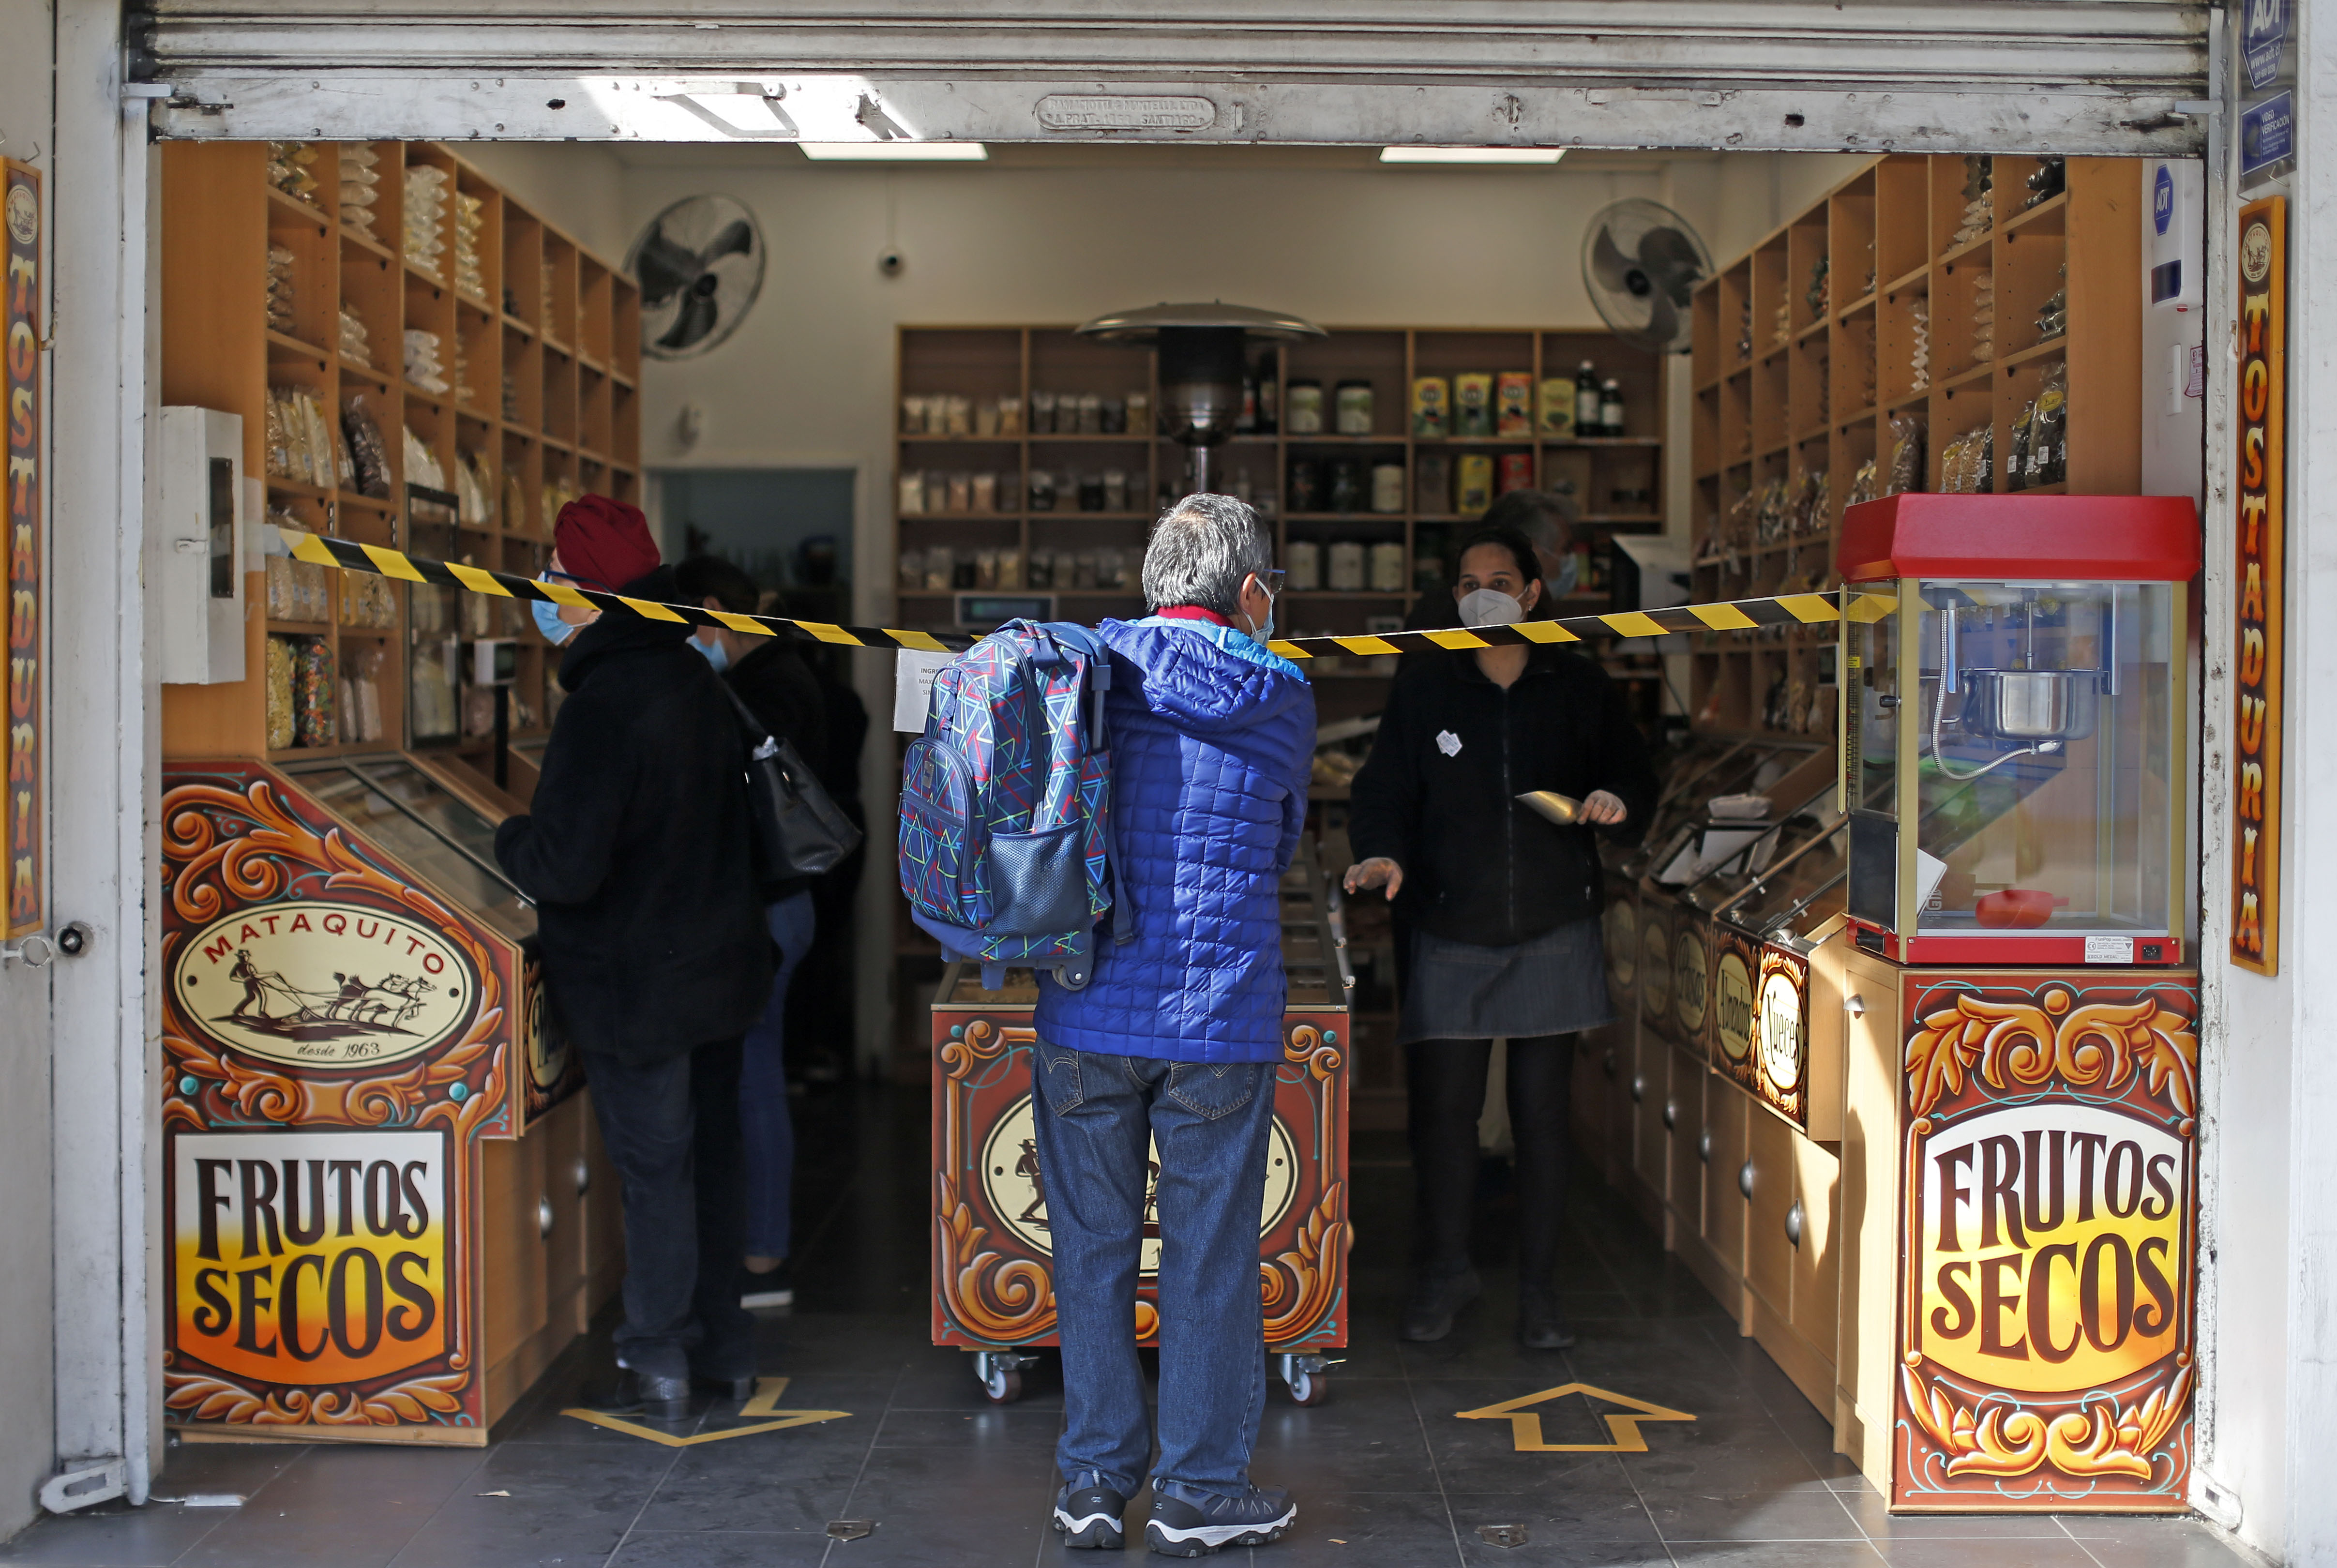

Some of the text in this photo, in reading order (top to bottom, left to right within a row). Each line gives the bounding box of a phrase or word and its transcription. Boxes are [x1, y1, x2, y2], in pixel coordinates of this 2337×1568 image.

[2250, 42, 2280, 70] www.adt.cl
[2262, 114, 2290, 136] VERIFICACIÓN
[2156, 187, 2170, 213] ADT
[9, 253, 36, 919] TOSTADURIA
[2236, 290, 2269, 952] TOSTADURIA
[202, 913, 444, 975] MATAQUITO
[297, 1041, 380, 1059] desde 1963
[1766, 990, 1800, 1070] Nueces
[193, 1159, 429, 1262] FRUTOS
[1933, 1130, 2176, 1252] FRUTOS
[193, 1247, 436, 1363] SECOS
[1930, 1233, 2175, 1364] SECOS
